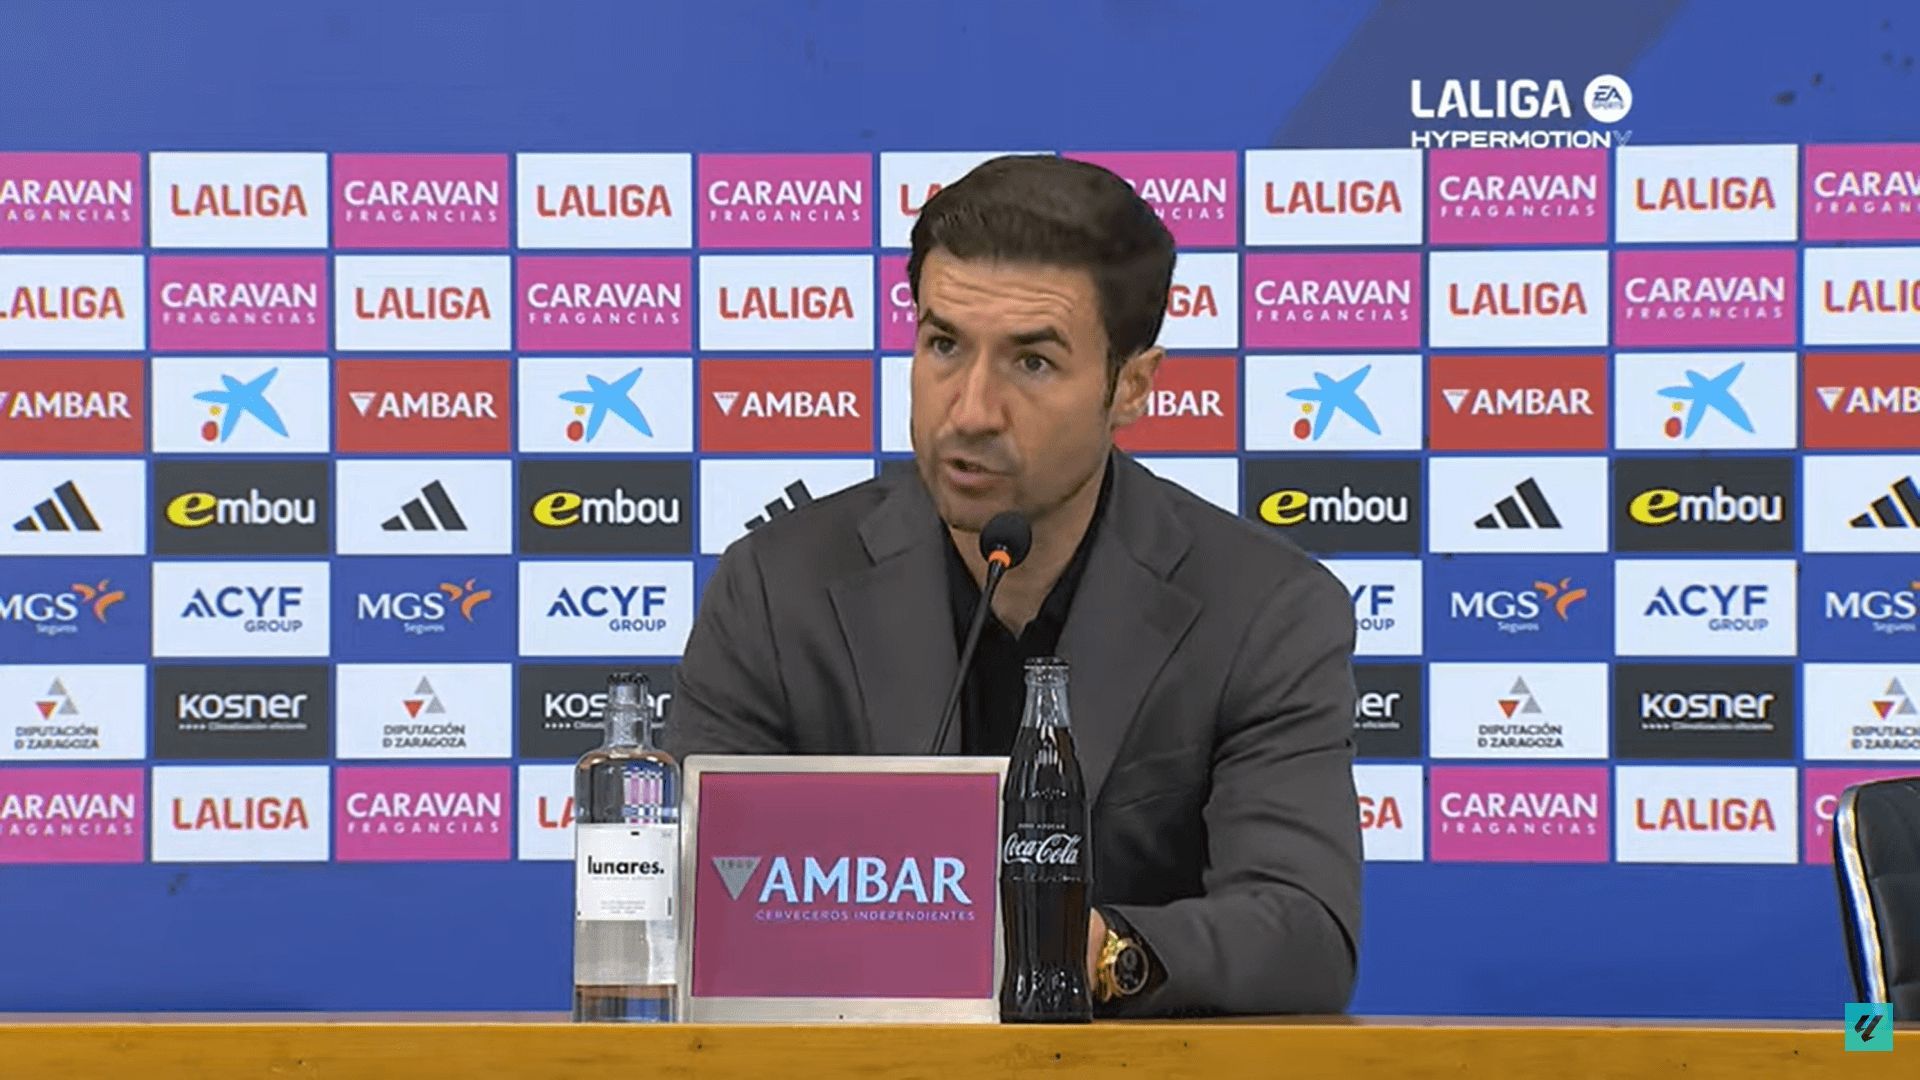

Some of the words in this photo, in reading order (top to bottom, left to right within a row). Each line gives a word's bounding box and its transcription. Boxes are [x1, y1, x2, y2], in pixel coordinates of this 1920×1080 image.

[0, 180, 131, 204] ARAVAN
[345, 181, 498, 205] CARAVAN
[709, 181, 861, 205] CARAVAN
[1124, 178, 1226, 203] AVAN
[1440, 175, 1596, 201] CARAVAN
[1636, 177, 1775, 211] LALIGA
[1814, 171, 1920, 197] CARAV
[172, 184, 307, 217] LALIGA
[538, 185, 671, 217] LALIGA
[1266, 181, 1401, 214] LALIGA
[1815, 202, 1920, 213] FRAGAN
[8, 209, 130, 221] AGANCIAS
[346, 210, 496, 222] FRAGANCIAS
[711, 210, 859, 221] FRAGANCIAS
[1154, 207, 1225, 219] NCIAS
[1441, 204, 1594, 217] FRAGANCIAS
[162, 283, 316, 307] CARAVAN
[528, 283, 680, 308] CARAVAN
[1255, 280, 1410, 305] CARAVAN
[1450, 282, 1587, 315] LALIGA
[1625, 277, 1784, 302] CARAVAN
[1824, 280, 1920, 313] LALI
[0, 286, 124, 319] ALIGA
[356, 287, 490, 320] LALIGA
[720, 286, 853, 319] LALIGA
[1257, 309, 1408, 321] FRAGANCIAS
[1627, 306, 1782, 318] FRAGANCIAS
[163, 312, 315, 324] FRAGANCIAS
[529, 312, 679, 324] FRAGANCIAS
[10, 392, 131, 418] AMBAR
[378, 392, 497, 418] AMBAR
[742, 392, 860, 417] AMBAR
[1147, 390, 1224, 416] BAR
[1472, 388, 1593, 414] AMBAR
[1846, 387, 1920, 413] AMB
[168, 489, 315, 525] embou
[534, 489, 678, 525] embou
[1261, 487, 1407, 523] embou
[1631, 486, 1781, 523] embou
[182, 587, 302, 618] ACYF
[359, 593, 444, 620] MGS
[547, 586, 666, 617] ACYF
[1452, 592, 1539, 619] MGS
[1644, 585, 1768, 616] ACYF
[1826, 591, 1917, 619] MGS
[244, 620, 303, 632] GROUP
[609, 619, 666, 632] GROUP
[1355, 618, 1395, 631] OUP
[1708, 618, 1768, 631] GROUP
[1865, 739, 1920, 749] ZARAGO
[0, 794, 134, 819] ARAVAN
[173, 797, 308, 830] LALIGA
[347, 793, 500, 817] CARAVAN
[1441, 793, 1597, 818] CARAVAN
[1636, 798, 1775, 831] LALIGA
[0, 825, 134, 835] AGANCIAS
[348, 822, 498, 833] FRAGANCIAS
[1442, 822, 1595, 834] FRAGANCIAS
[1004, 832, 1081, 864] Coca-Cola
[588, 856, 664, 874] lunares.
[758, 856, 972, 904] AMBAR
[756, 910, 848, 921] CERVECEROS
[854, 910, 976, 921] INDEPENDIENTES
